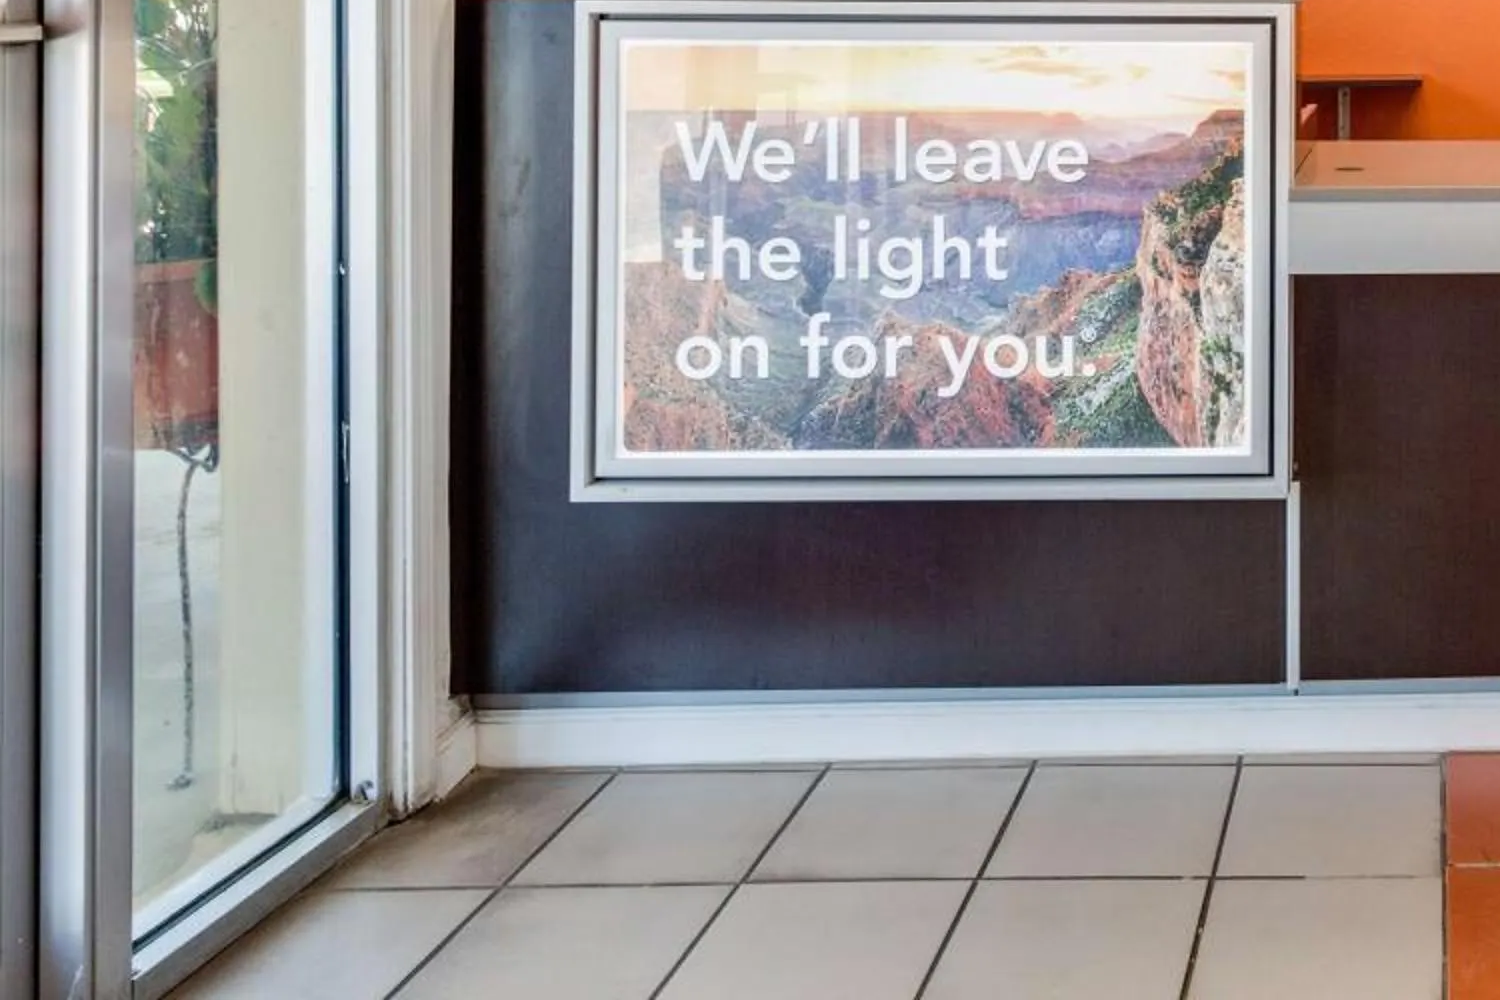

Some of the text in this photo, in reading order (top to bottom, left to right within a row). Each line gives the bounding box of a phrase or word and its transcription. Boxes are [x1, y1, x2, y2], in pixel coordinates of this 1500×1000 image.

[673, 117, 1089, 183] We'll leave
[674, 217, 1008, 299] the light
[676, 335, 769, 380] on
[799, 312, 912, 380] for
